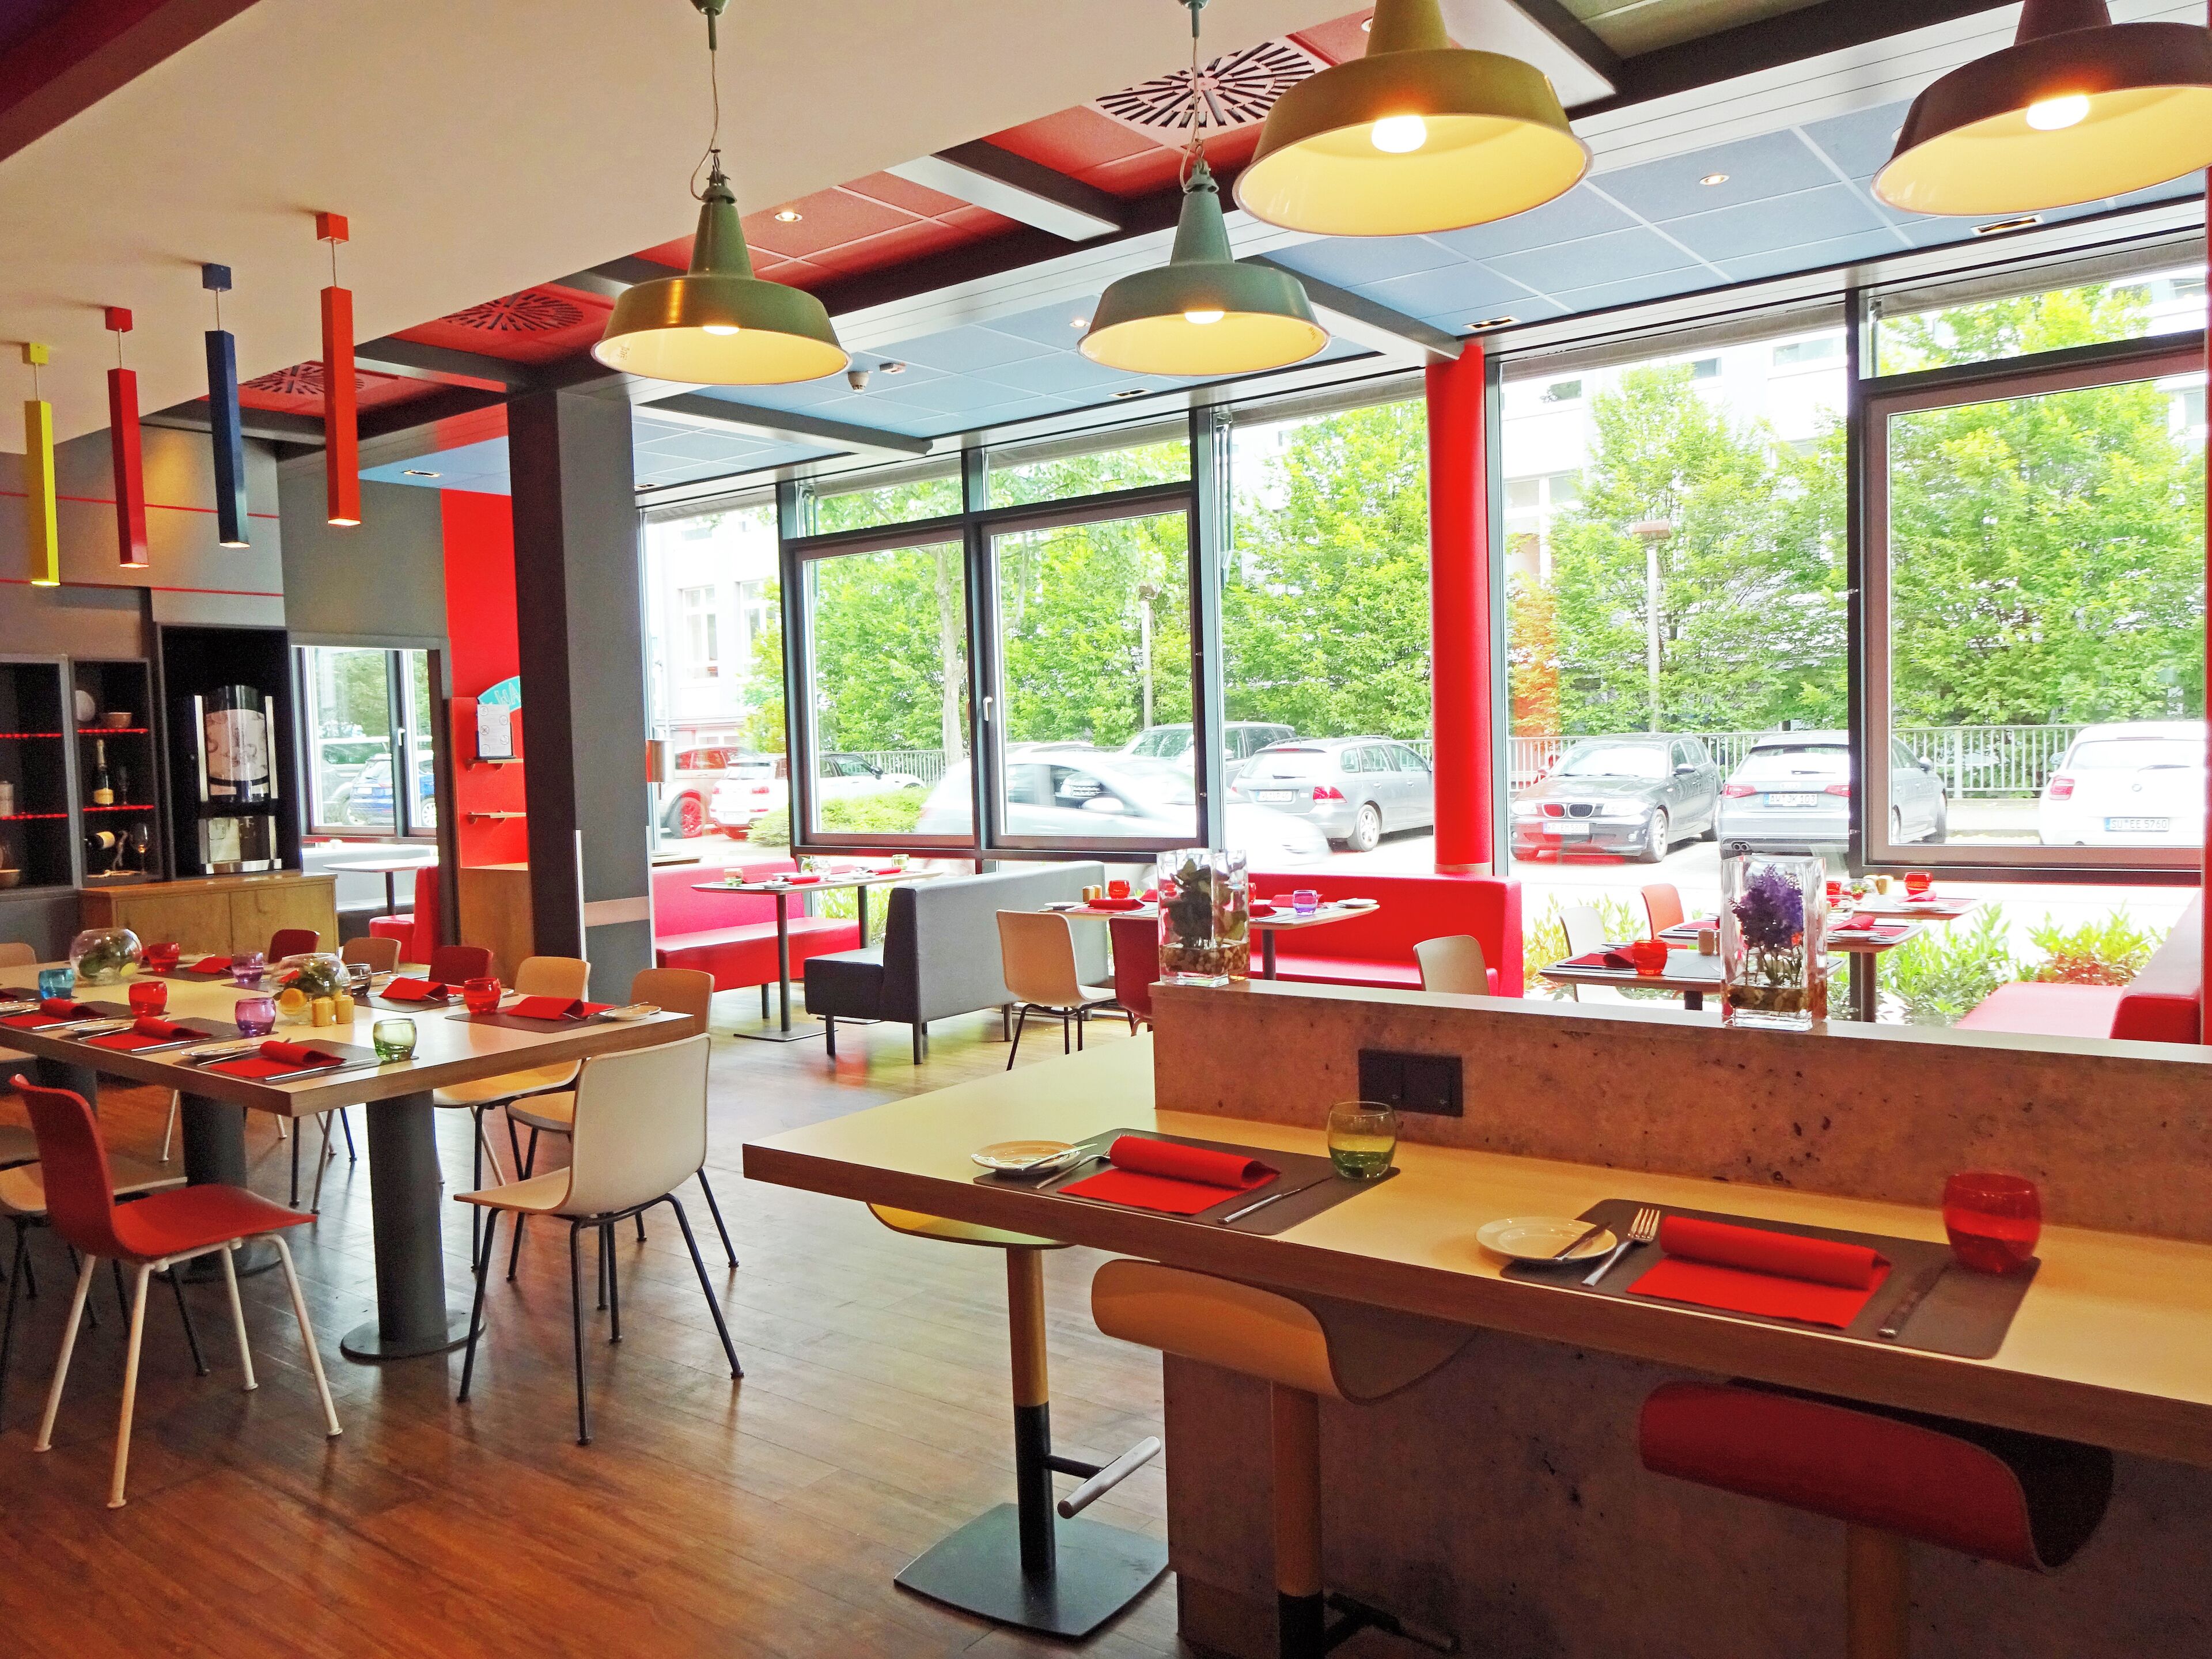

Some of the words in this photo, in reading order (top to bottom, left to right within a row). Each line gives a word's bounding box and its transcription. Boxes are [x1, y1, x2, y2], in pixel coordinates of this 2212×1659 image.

[1787, 795, 1797, 803] JK
[1800, 795, 1816, 803] 103
[2112, 820, 2123, 828] SU
[2130, 820, 2141, 828] EE
[2144, 820, 2167, 828] 5760
